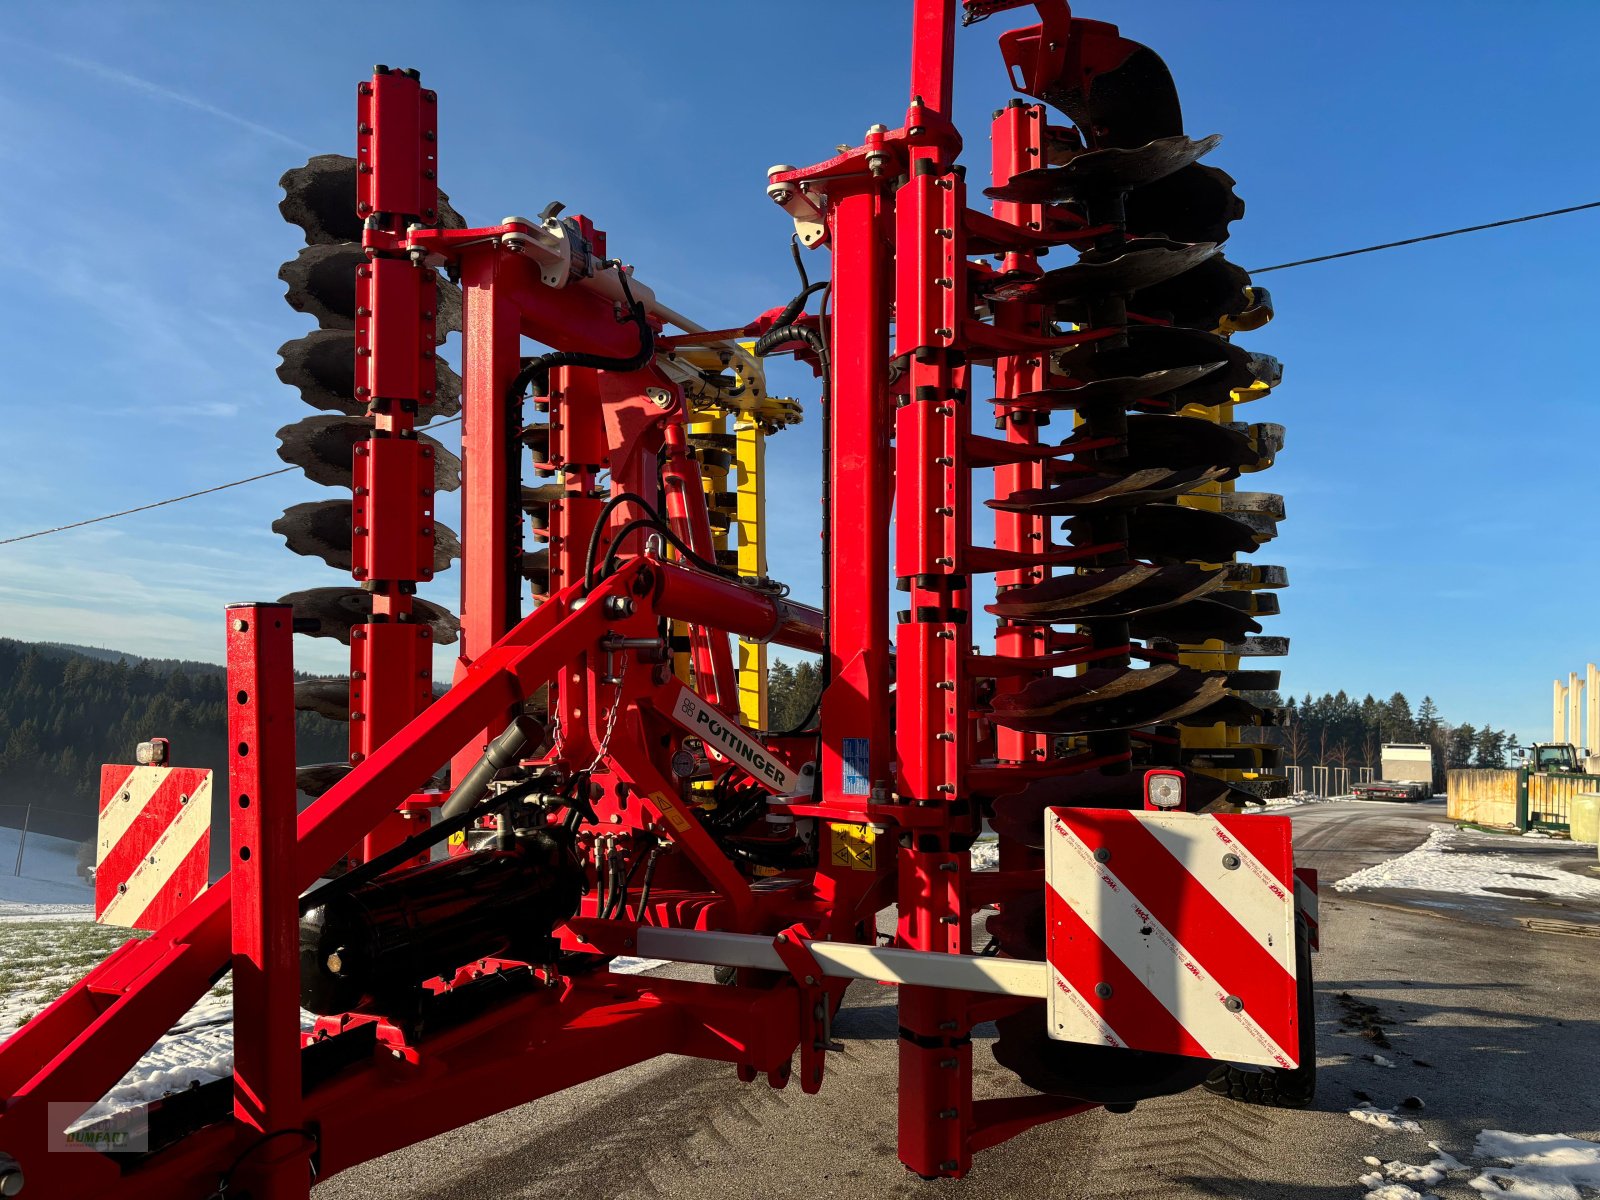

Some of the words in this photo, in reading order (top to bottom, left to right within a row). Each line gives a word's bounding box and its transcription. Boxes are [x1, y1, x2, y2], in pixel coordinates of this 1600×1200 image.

[1055, 823, 1069, 837] WGF
[1216, 830, 1232, 844] WGF
[1268, 884, 1285, 899] WGF
[1185, 962, 1200, 977] WGF
[1056, 980, 1071, 994] WGF
